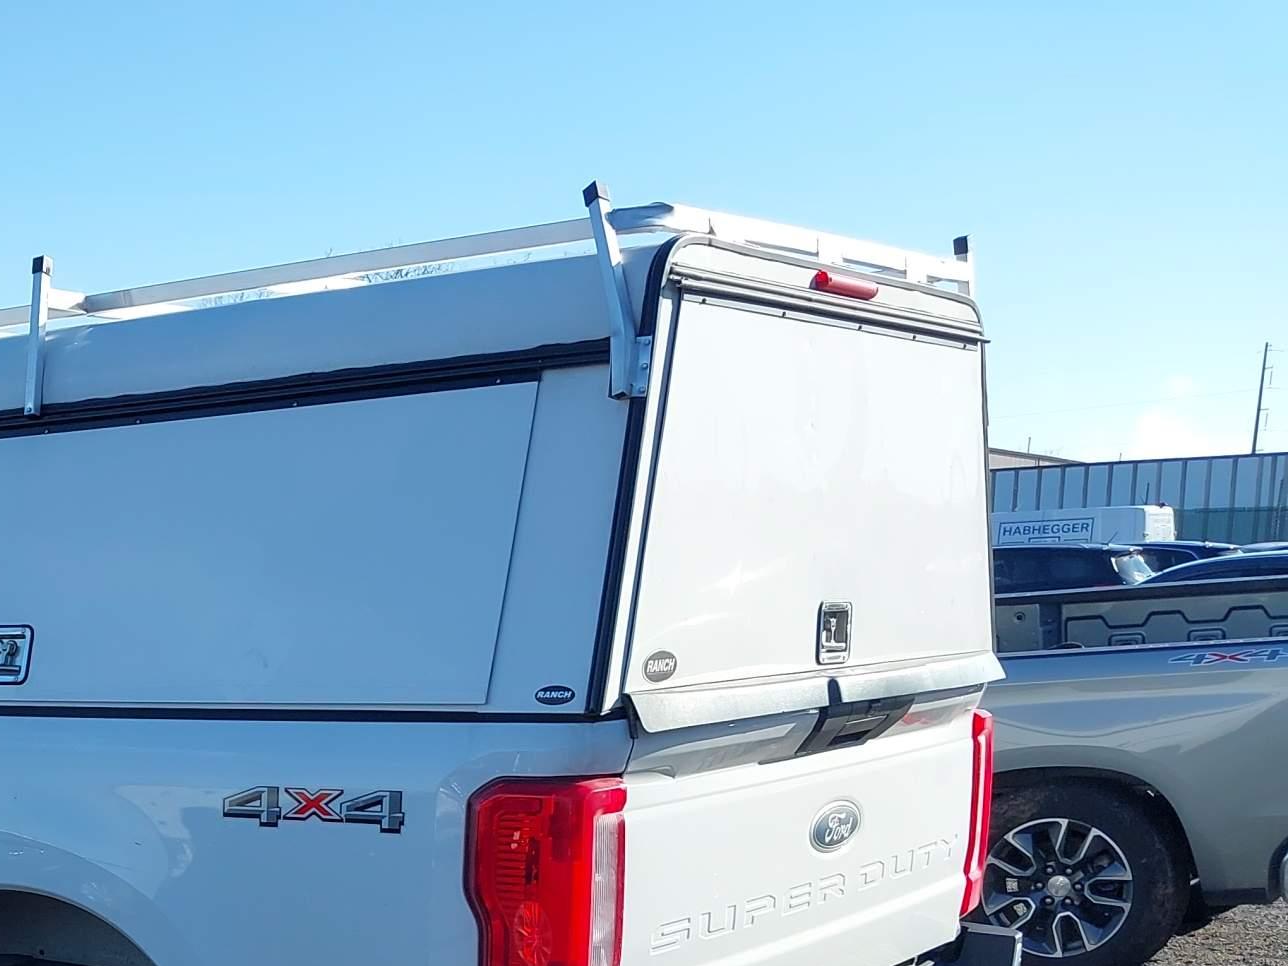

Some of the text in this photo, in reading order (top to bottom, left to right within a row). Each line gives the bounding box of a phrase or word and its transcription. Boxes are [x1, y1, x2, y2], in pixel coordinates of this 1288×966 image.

[1003, 522, 1090, 537] HABHEGGER
[647, 657, 676, 673] RANCH
[536, 690, 573, 699] RANCH
[824, 812, 853, 844] Ford
[649, 832, 959, 955] SUPER DUTY
